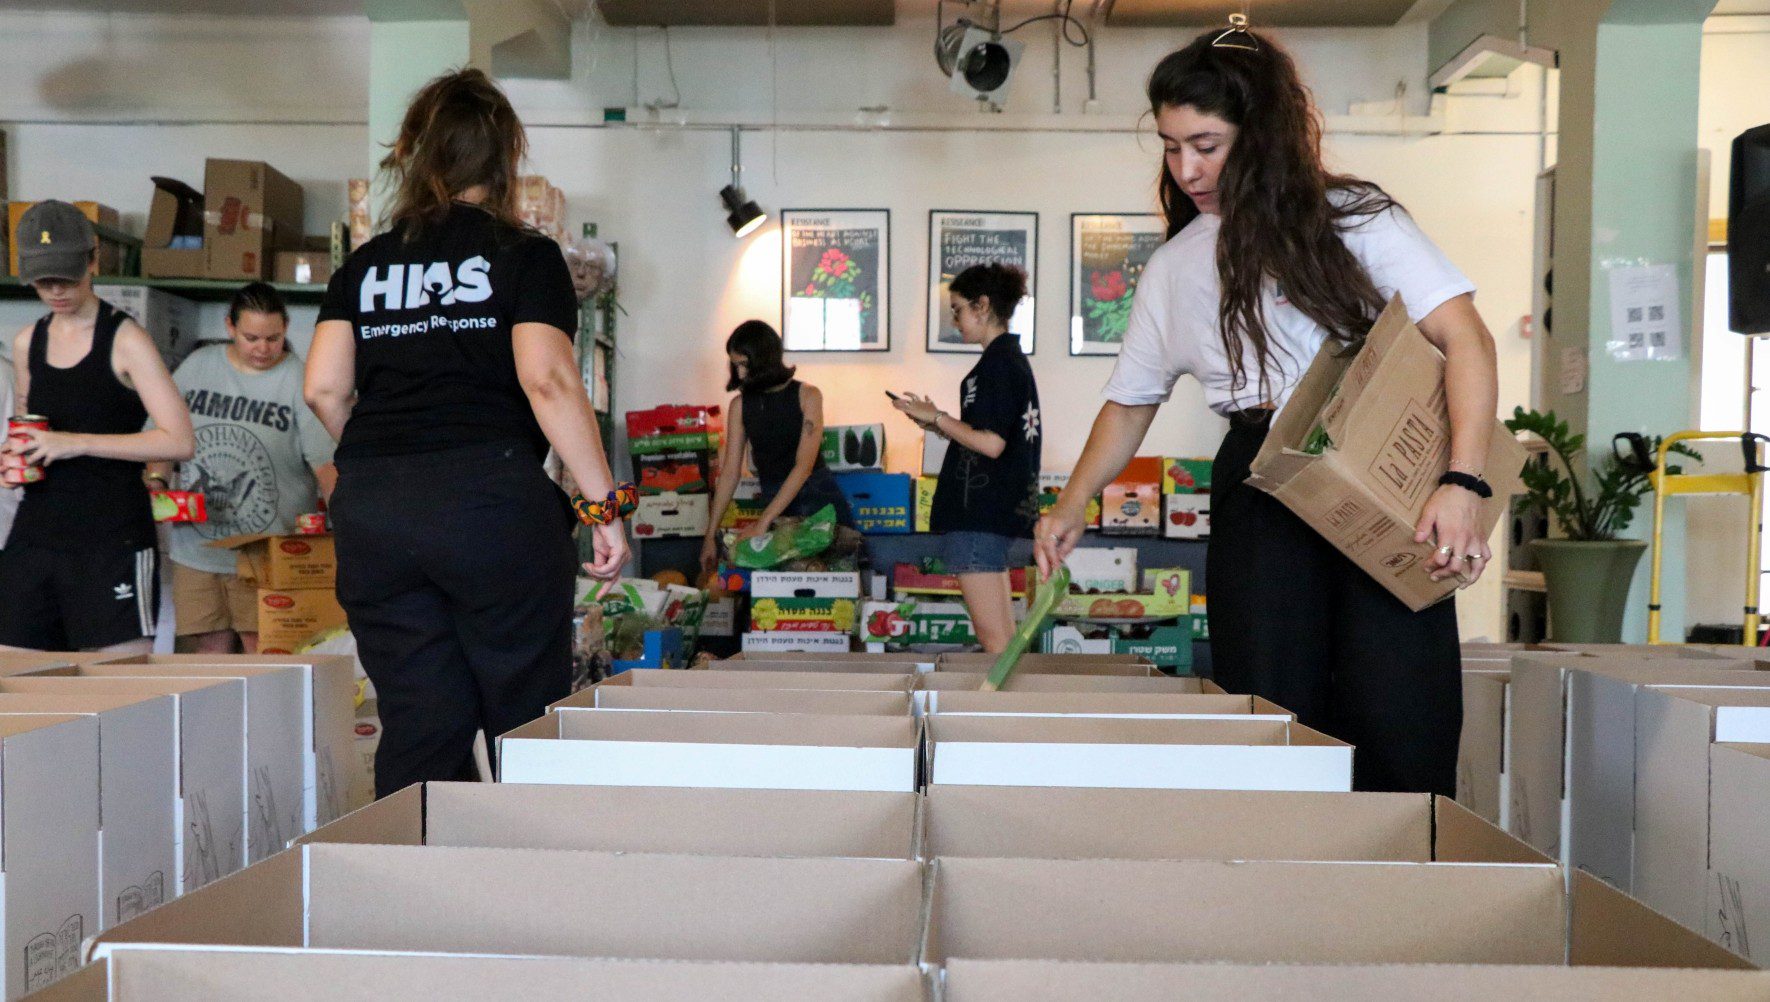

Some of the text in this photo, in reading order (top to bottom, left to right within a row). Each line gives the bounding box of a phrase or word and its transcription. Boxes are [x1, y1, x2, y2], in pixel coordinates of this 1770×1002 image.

[944, 231, 1000, 245] FIGHT THE
[360, 255, 493, 313] HIAS
[361, 315, 497, 339] Emergency Response
[1393, 413, 1435, 467] PASTA
[1085, 579, 1125, 588] GINGER
[890, 619, 976, 640] רקות
